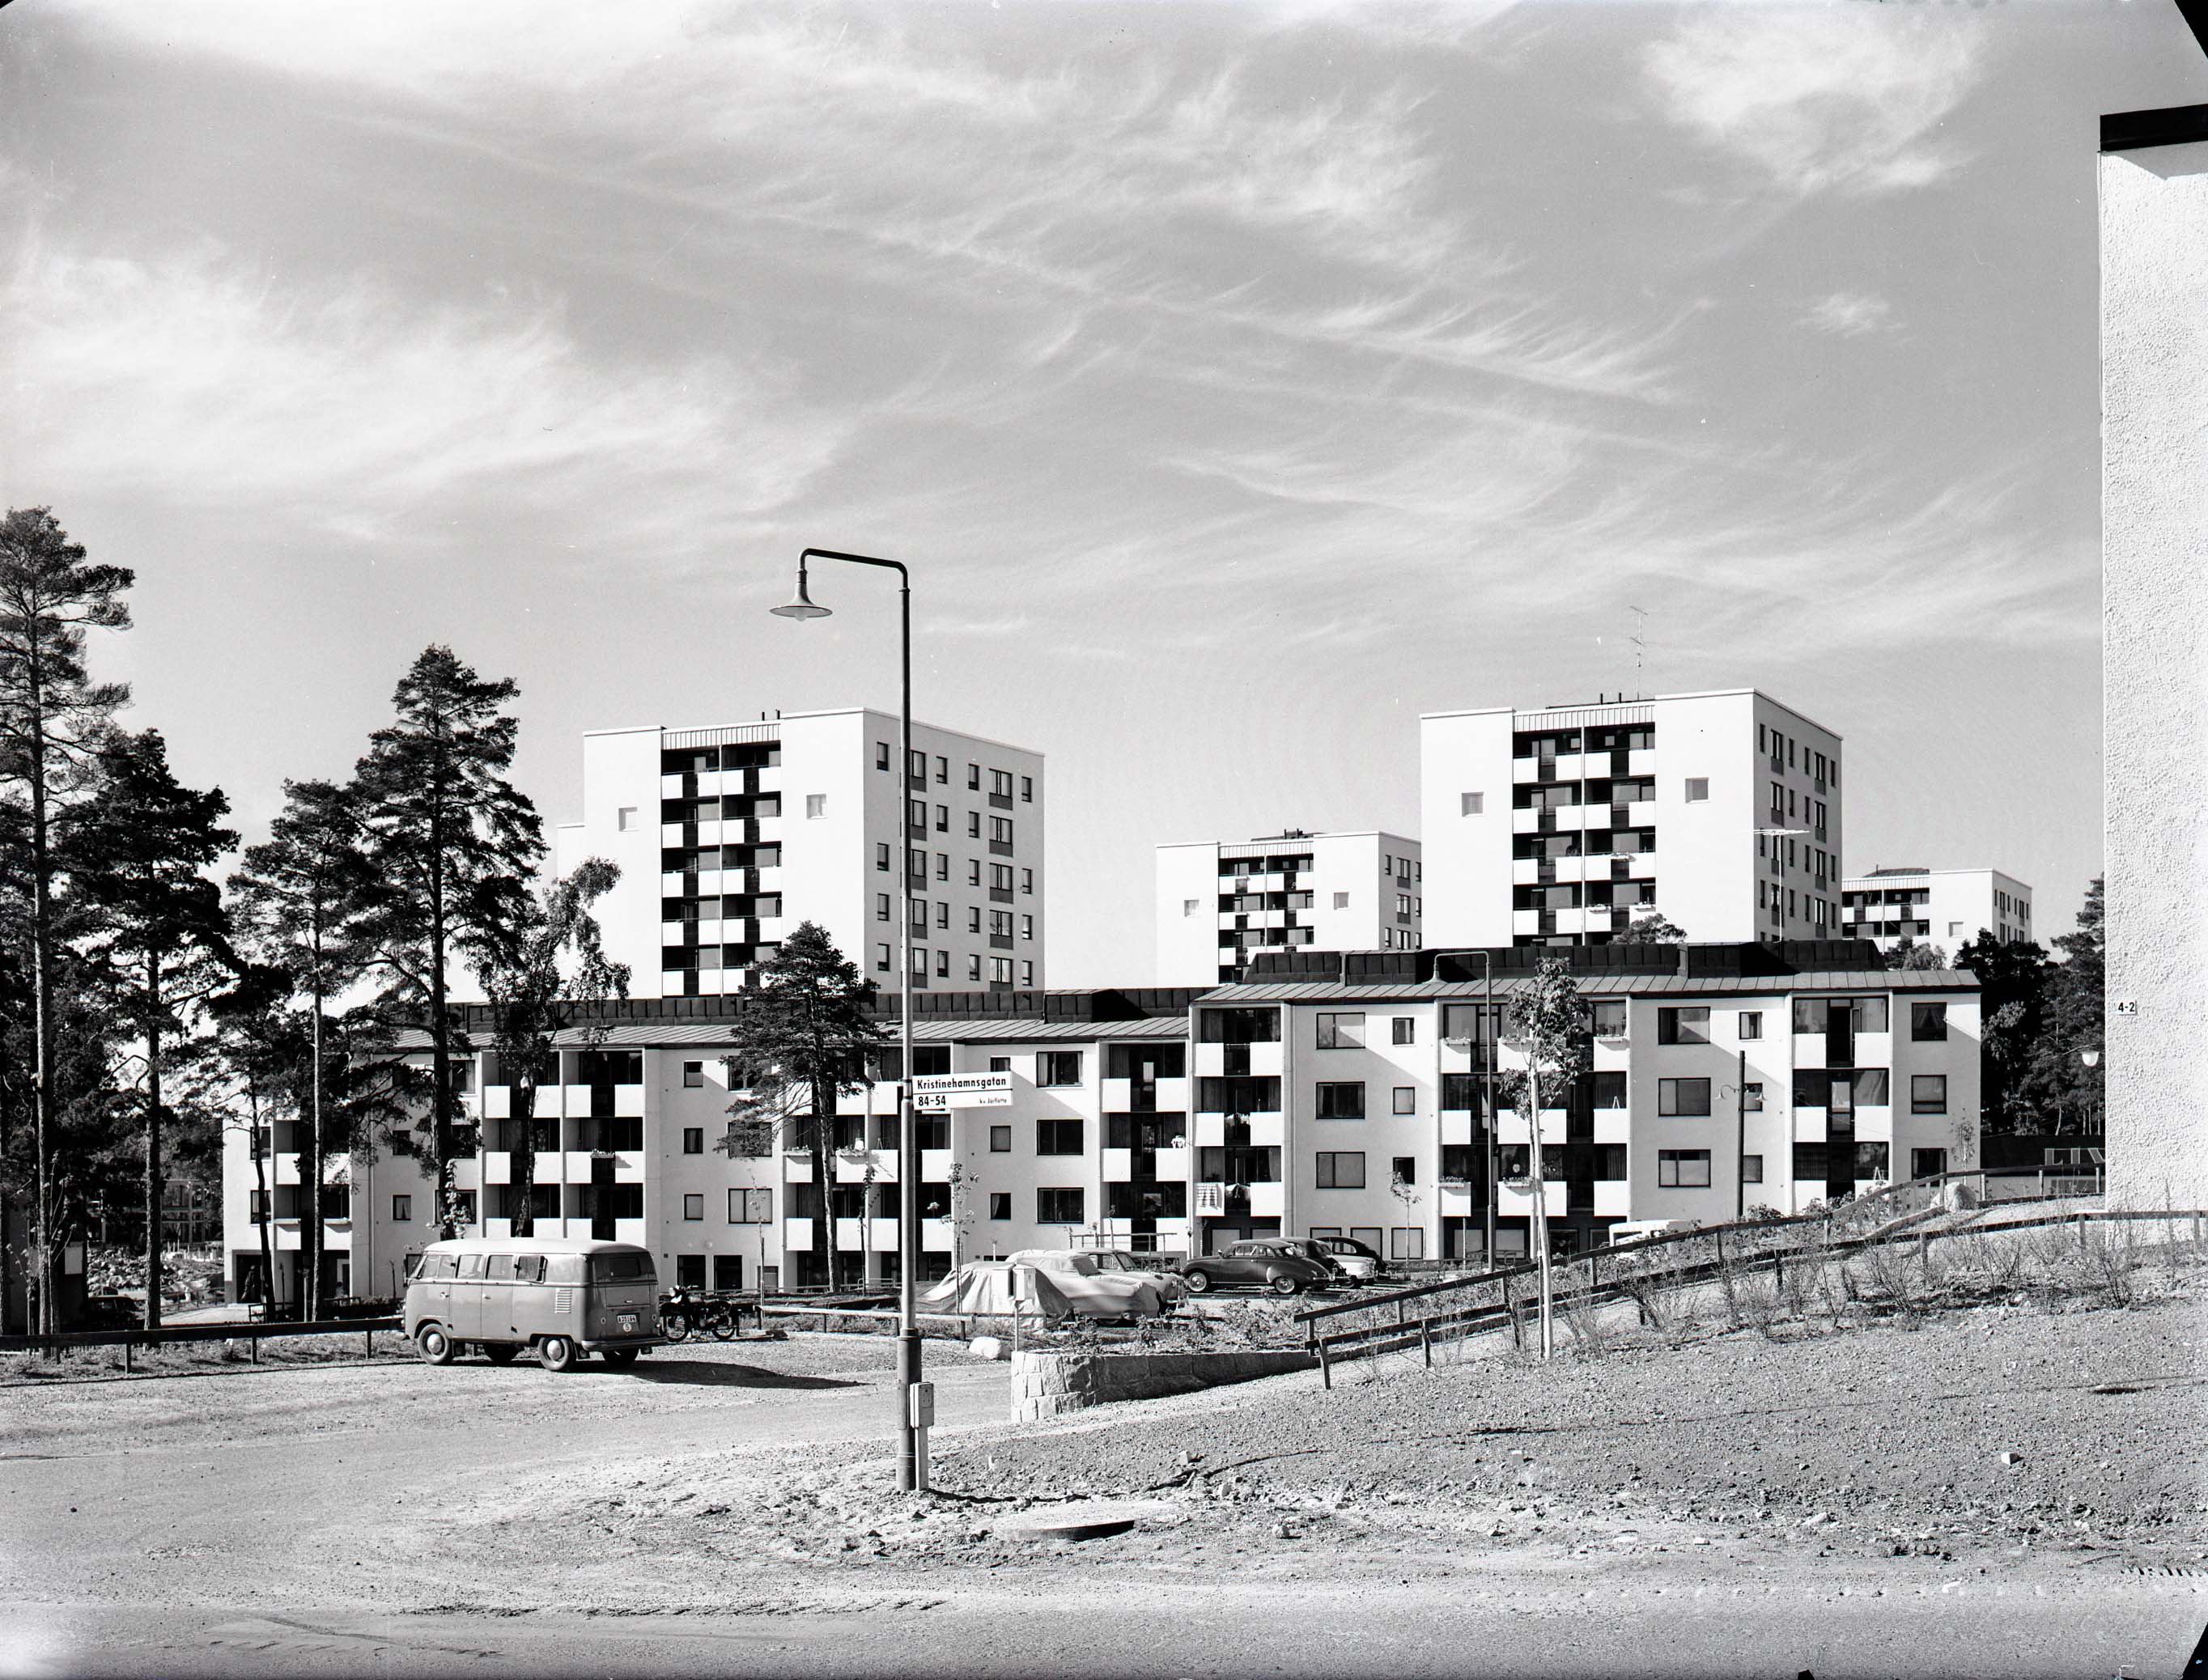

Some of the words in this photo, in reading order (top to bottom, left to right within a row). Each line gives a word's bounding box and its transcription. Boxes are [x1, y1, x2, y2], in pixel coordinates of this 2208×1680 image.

[2117, 1002, 2135, 1012] 4-2
[917, 1076, 1006, 1090] Kristinehamnsgatan
[918, 1095, 946, 1106] 84-54
